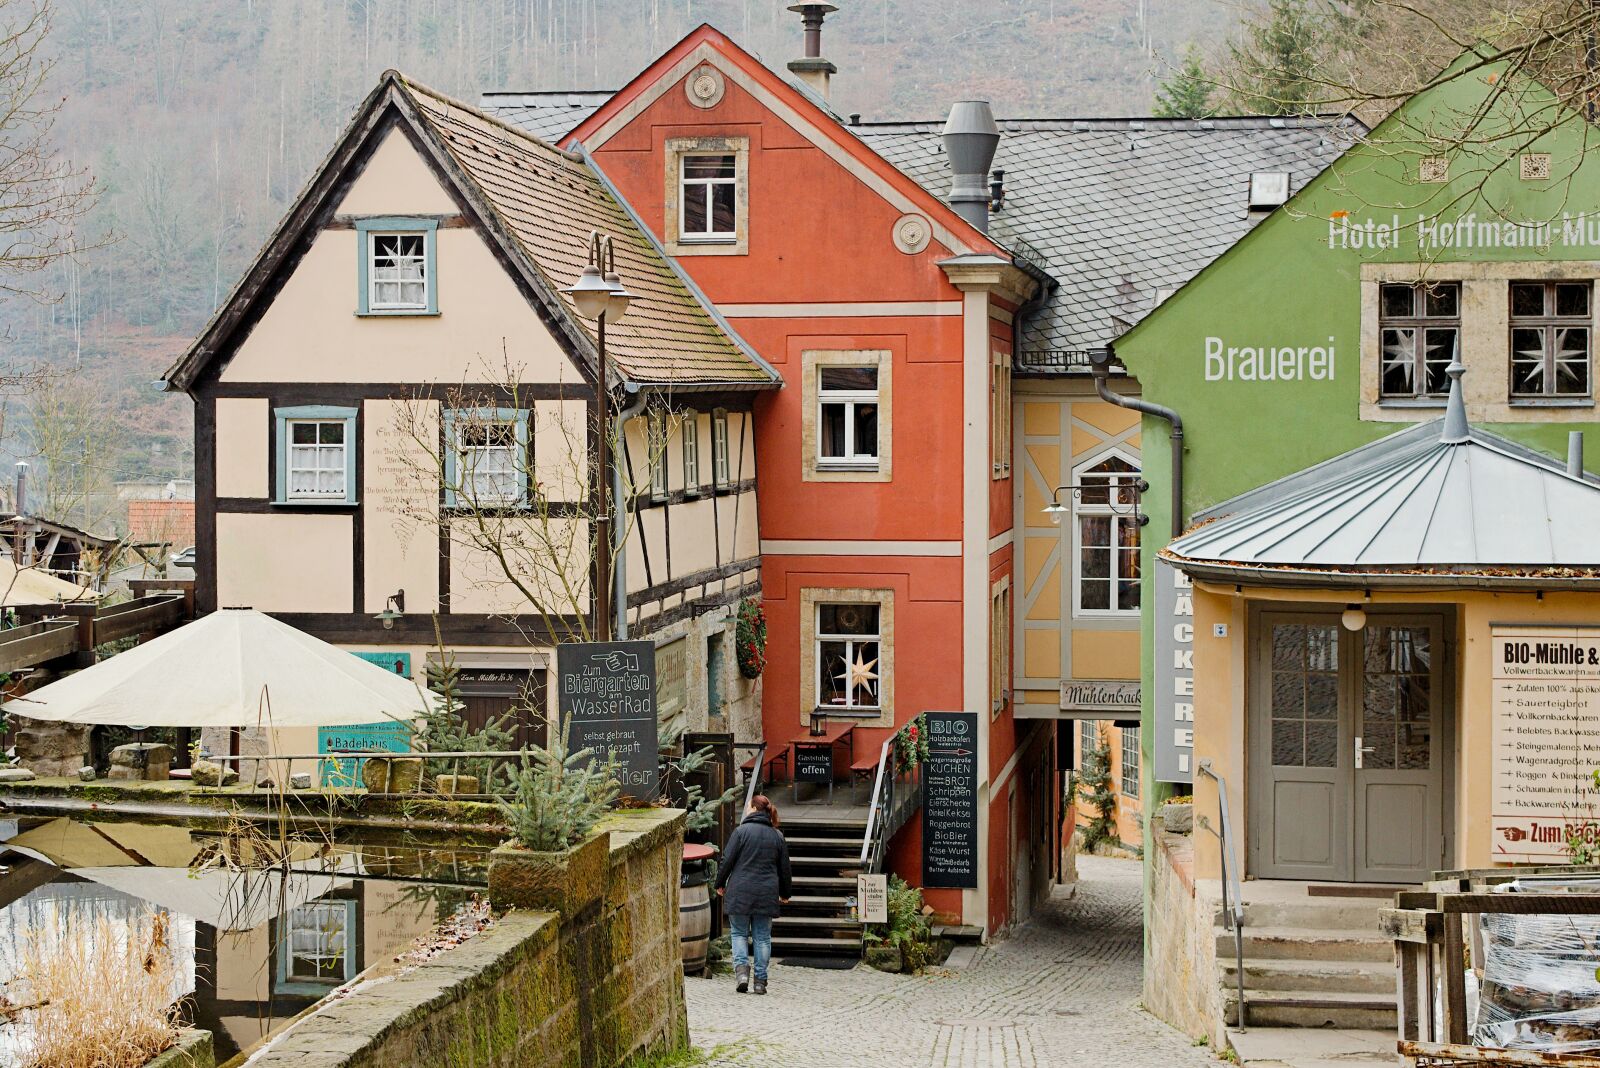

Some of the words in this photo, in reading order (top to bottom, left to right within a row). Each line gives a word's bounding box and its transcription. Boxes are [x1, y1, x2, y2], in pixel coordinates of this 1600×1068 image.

[1328, 214, 1399, 249] Hotel
[1204, 336, 1335, 381] Brauerei
[1504, 642, 1585, 665] BIO-Mühle
[1587, 647, 1600, 665] &
[582, 664, 601, 676] Zum
[1503, 666, 1586, 676] Vollwertbackwaren
[564, 672, 650, 698] Biergarten
[571, 693, 652, 716] WasserRad
[1516, 698, 1588, 710] Sauerteigbrot
[1516, 711, 1599, 721] Vollkornbackwaren
[930, 720, 969, 735] BIO
[1516, 726, 1552, 735] Belebtes
[583, 731, 605, 741] selbst
[606, 730, 636, 742] gebraut
[929, 735, 971, 743] Holzbackofen
[335, 737, 388, 749] Badehaus
[1516, 741, 1582, 753] Steingemalenes
[797, 754, 830, 762] Gaststube
[1516, 755, 1584, 767] Wagenradgroße
[801, 765, 826, 775] offen
[930, 763, 971, 774] KUCHEN
[945, 776, 971, 786] BROT
[1515, 770, 1547, 781] Roggen
[1551, 771, 1559, 780] &
[929, 787, 971, 797] Schrippen
[1563, 786, 1571, 794] in
[929, 799, 971, 808] Eierschecke
[1515, 799, 1560, 808] Backwaren
[929, 820, 971, 829] Roggenbrot
[934, 831, 968, 841] BioBier
[1530, 822, 1562, 843] Zum
